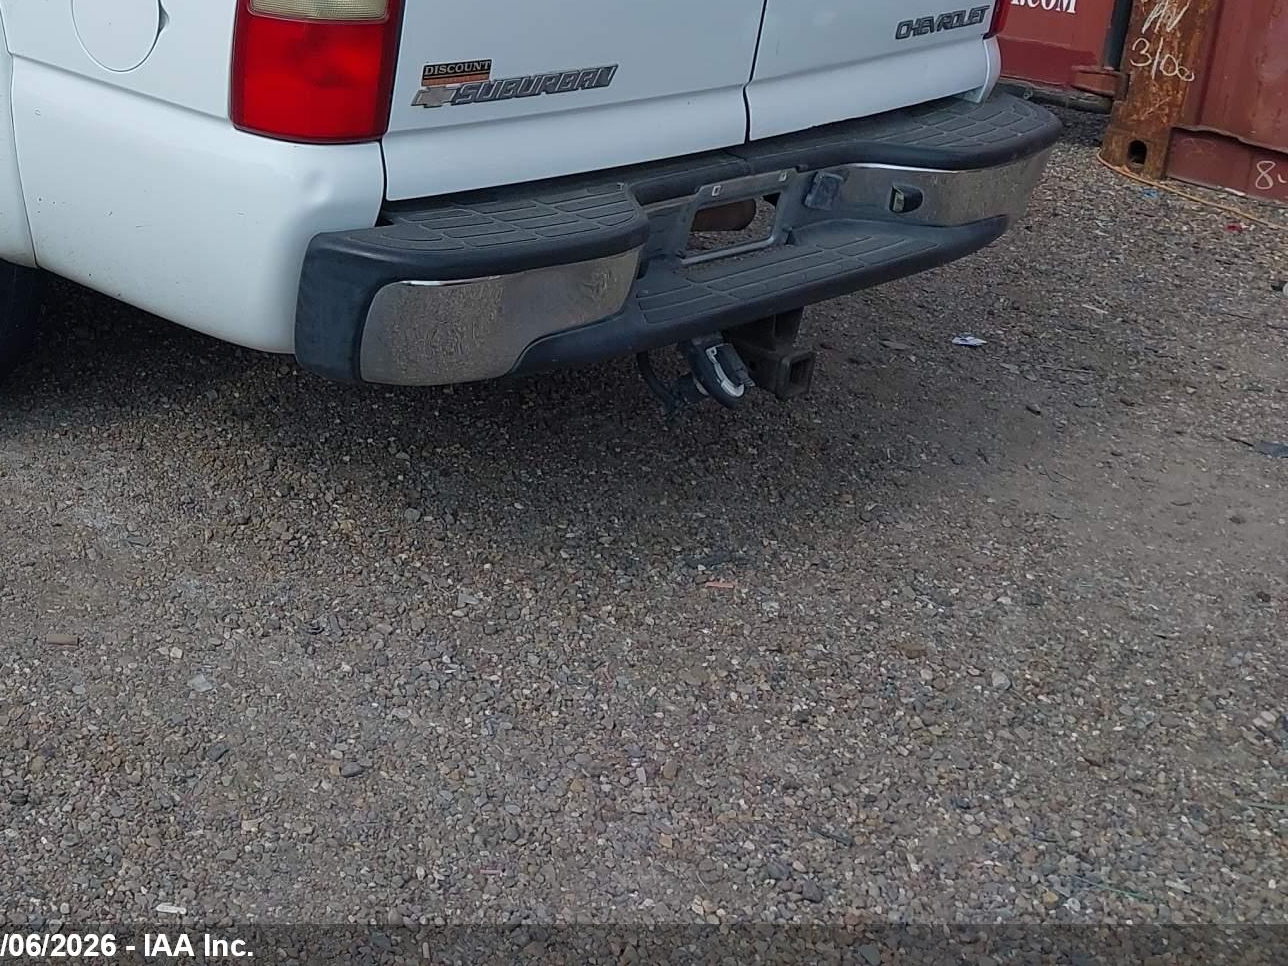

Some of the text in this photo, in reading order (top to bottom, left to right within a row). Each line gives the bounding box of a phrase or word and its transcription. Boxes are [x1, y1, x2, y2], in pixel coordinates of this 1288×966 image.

[895, 4, 991, 40] CHEVROLET
[423, 60, 492, 76] DISCOUNT
[450, 63, 620, 106] SUBURBAN
